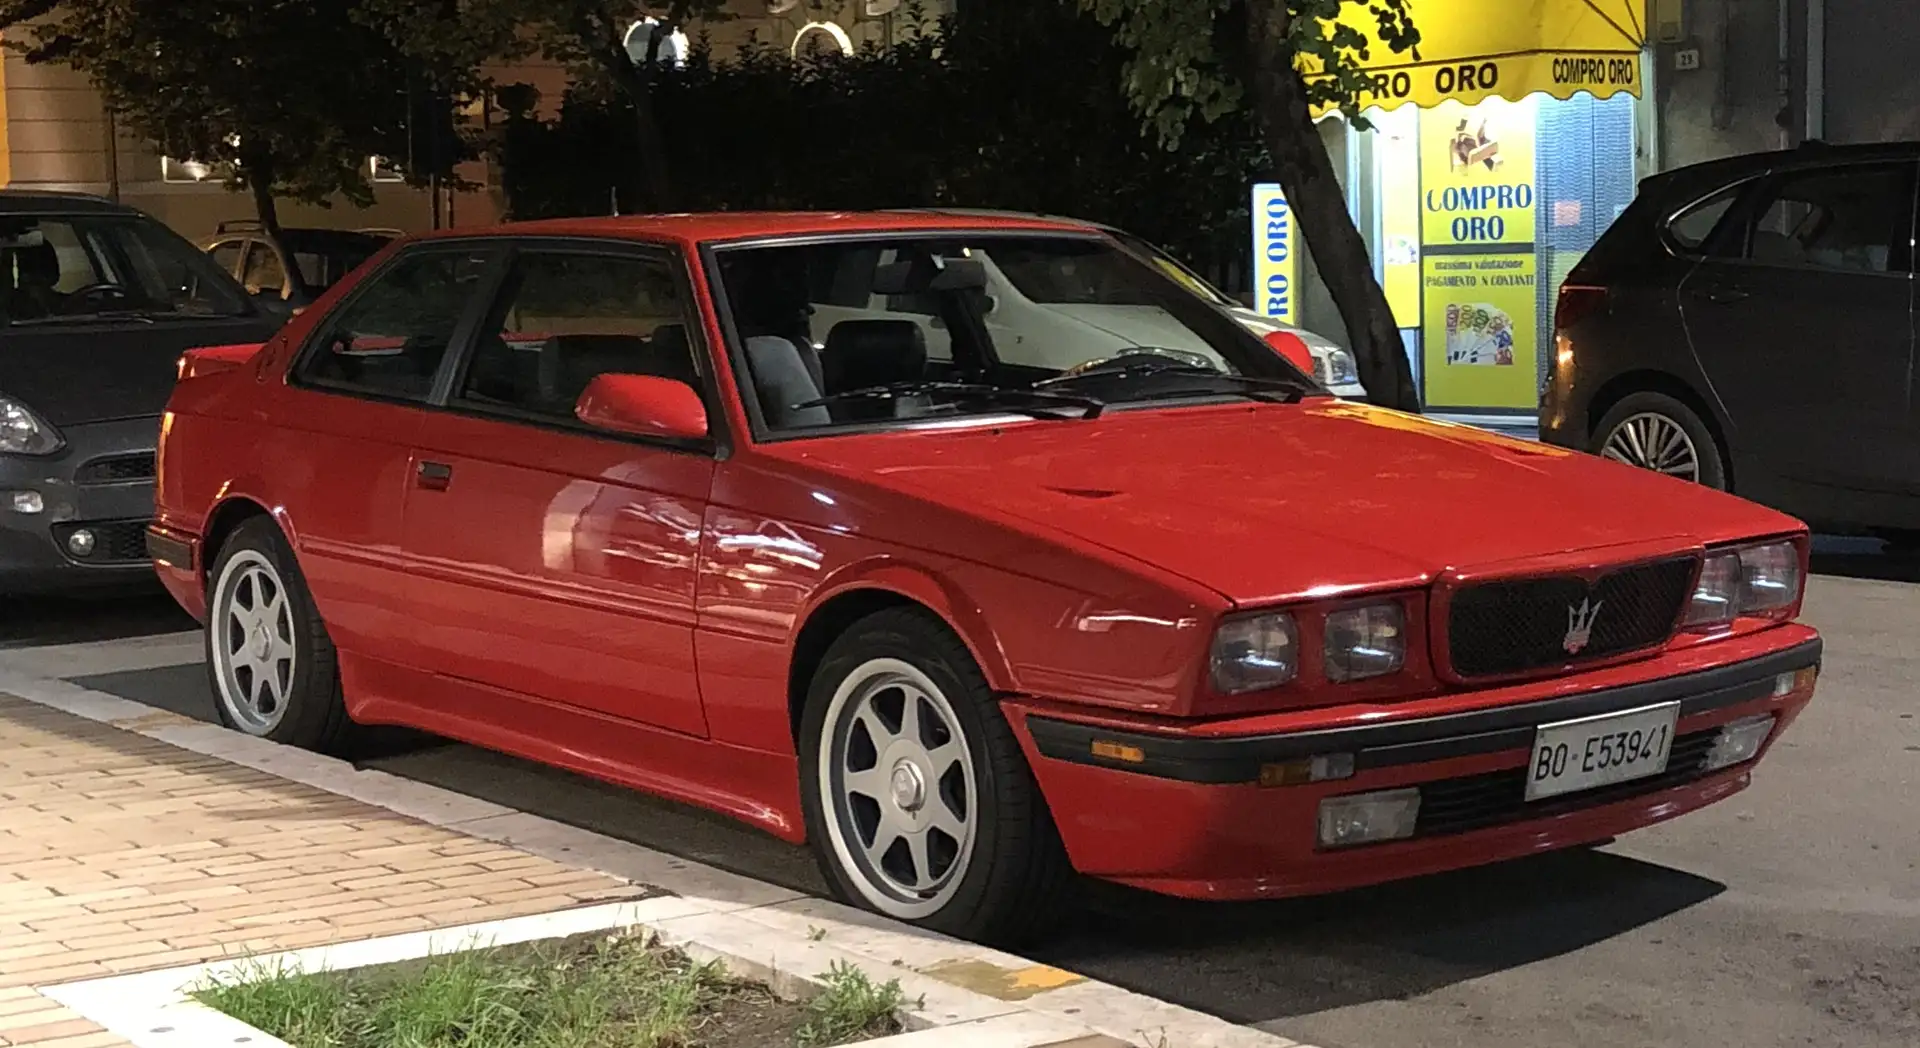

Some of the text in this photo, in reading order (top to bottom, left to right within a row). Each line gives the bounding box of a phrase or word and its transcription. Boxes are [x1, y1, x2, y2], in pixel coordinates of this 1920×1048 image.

[1435, 62, 1498, 94] ORO
[1553, 58, 1633, 84] COMPRO ORO
[1427, 183, 1532, 212] COMPRO
[1267, 198, 1288, 262] ORO
[1452, 215, 1504, 241] ORO
[1535, 724, 1667, 780] BO E53941
